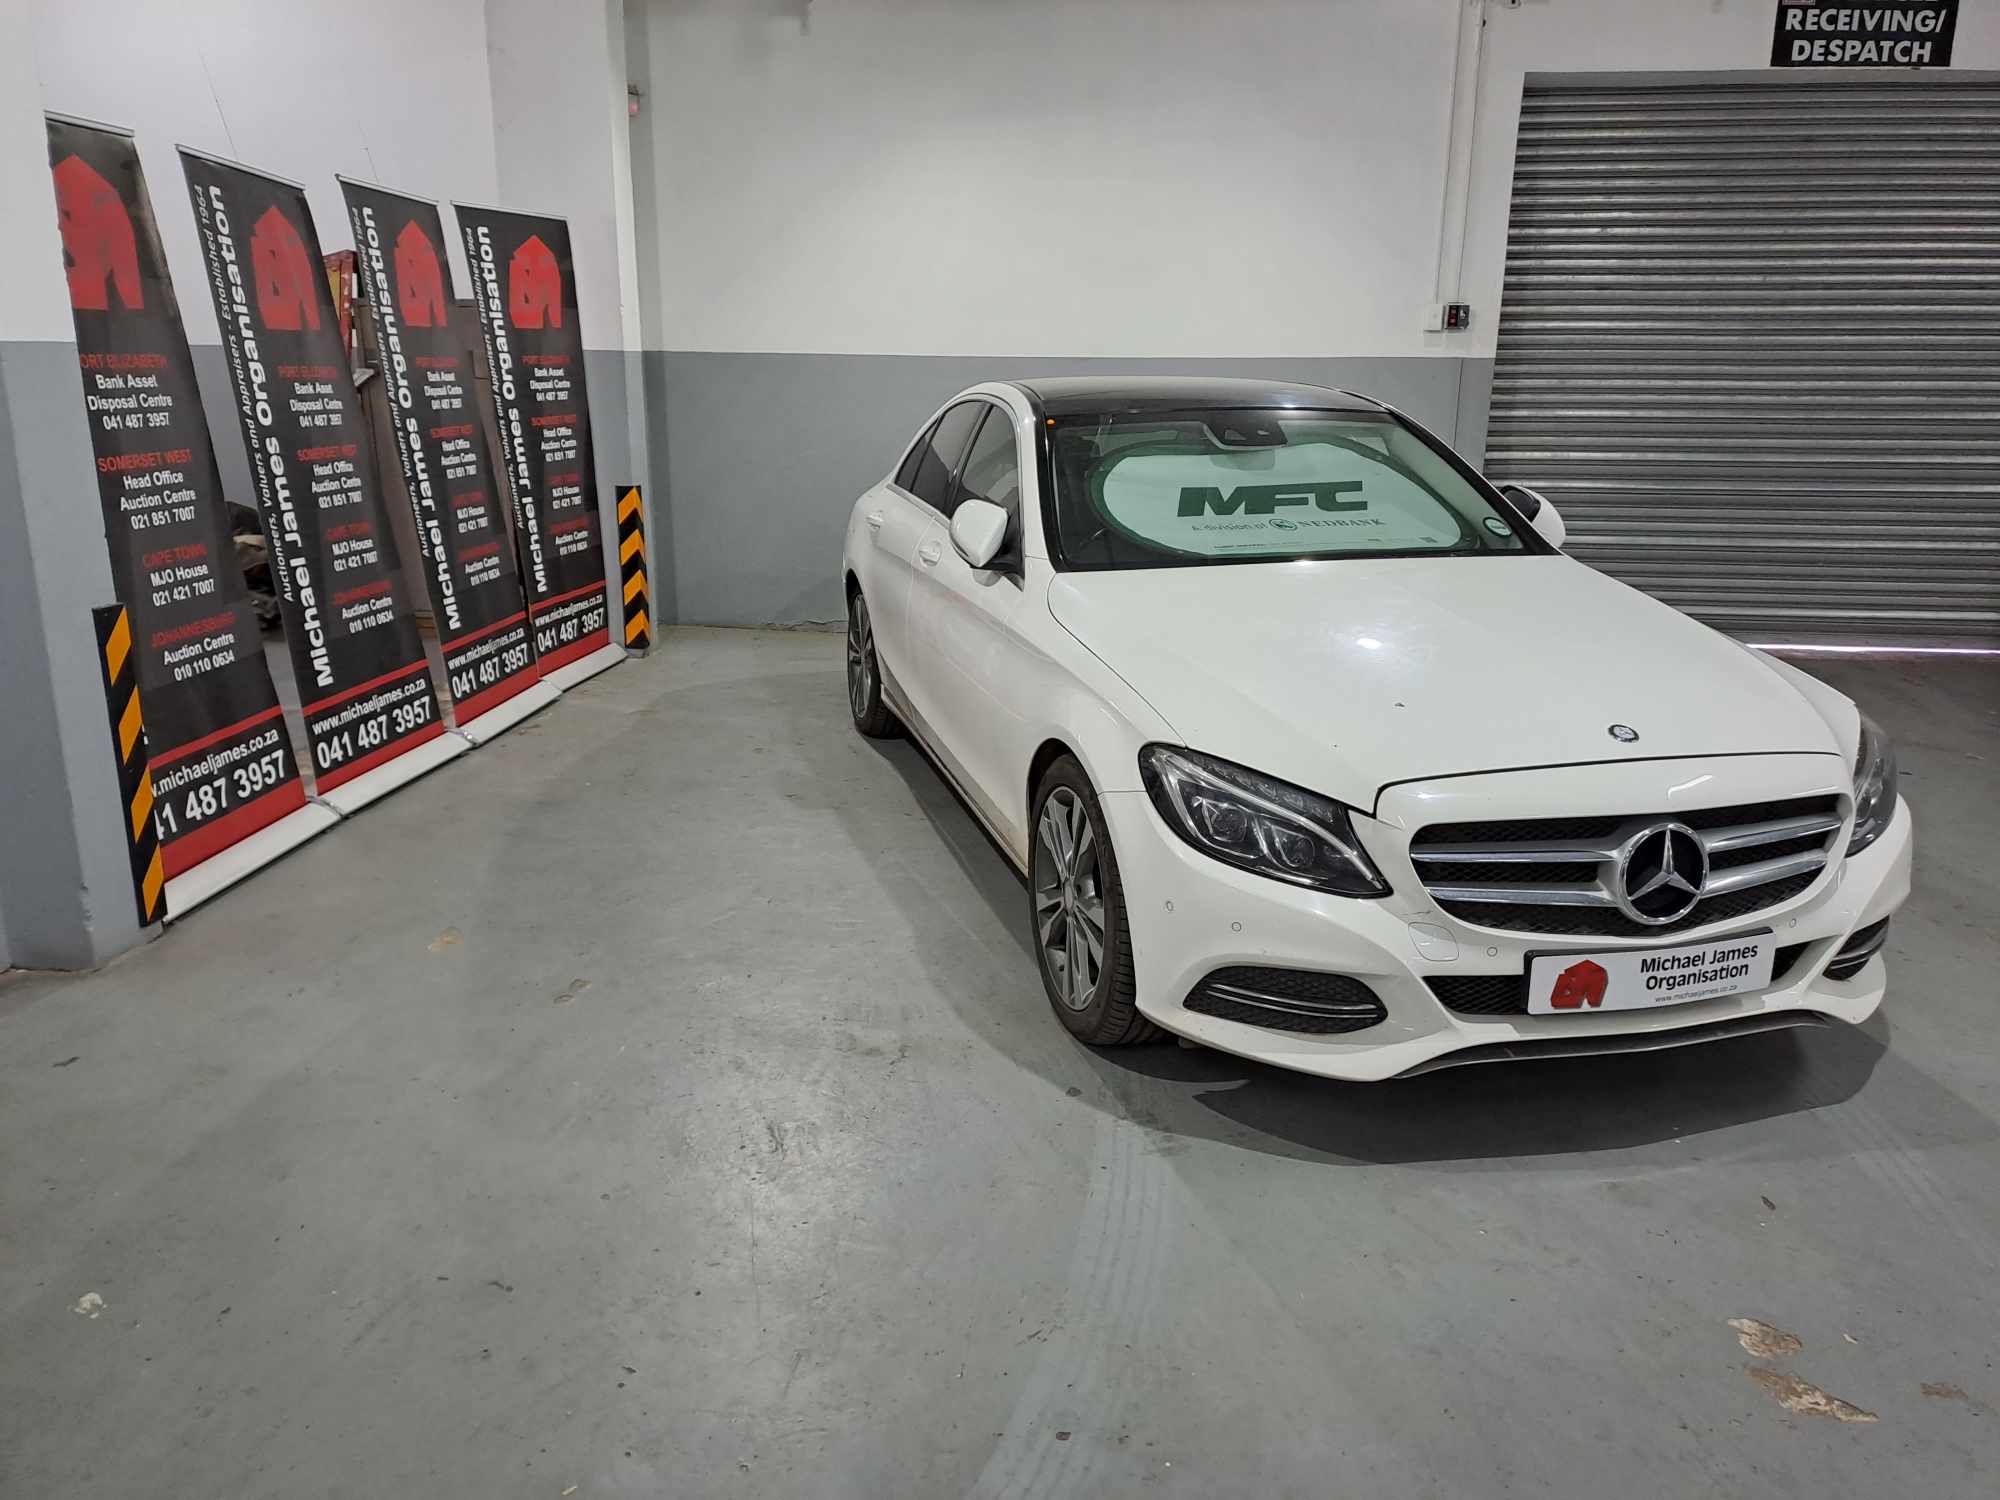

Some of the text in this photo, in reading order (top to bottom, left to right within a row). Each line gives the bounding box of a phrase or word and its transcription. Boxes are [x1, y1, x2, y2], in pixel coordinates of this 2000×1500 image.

[1785, 8, 1947, 33] RECEIVING/
[1791, 39, 1932, 63] DESPATCH
[194, 184, 210, 225] 1964
[206, 228, 231, 320] Established
[362, 206, 412, 408] Organisation
[96, 374, 158, 389] Bank Asset
[229, 334, 251, 415] Appraisers
[87, 393, 173, 412] Disposal Centre
[477, 226, 548, 592] Michael James Organisation
[103, 412, 170, 430] 041 487 3957
[209, 185, 334, 687] Michael James Organisation
[245, 418, 260, 448] and
[123, 470, 184, 490] Head Office
[255, 452, 272, 507] Valuers
[406, 417, 435, 511] James
[120, 488, 196, 512] Auction Centre
[1177, 480, 1368, 517] MFC
[131, 506, 195, 530] 021 851 7007
[1297, 518, 1386, 528] NEDBANK
[268, 513, 294, 601] Auctioneers,
[426, 519, 462, 630] Michael
[151, 564, 209, 587] MJO House
[152, 579, 215, 607] 021 421 7007
[537, 607, 604, 652] 041 487 3957
[163, 632, 235, 665] Auction Centre
[174, 650, 235, 681] 010 110 0634
[452, 643, 529, 699] 041 487 3957
[312, 678, 426, 735] www.michaeljames.co.za
[317, 696, 431, 769] 041 487 3957
[185, 777, 228, 821] 487
[233, 749, 285, 798] 3957
[1640, 945, 1758, 974] Michael James
[1646, 964, 1749, 991] Organisation
